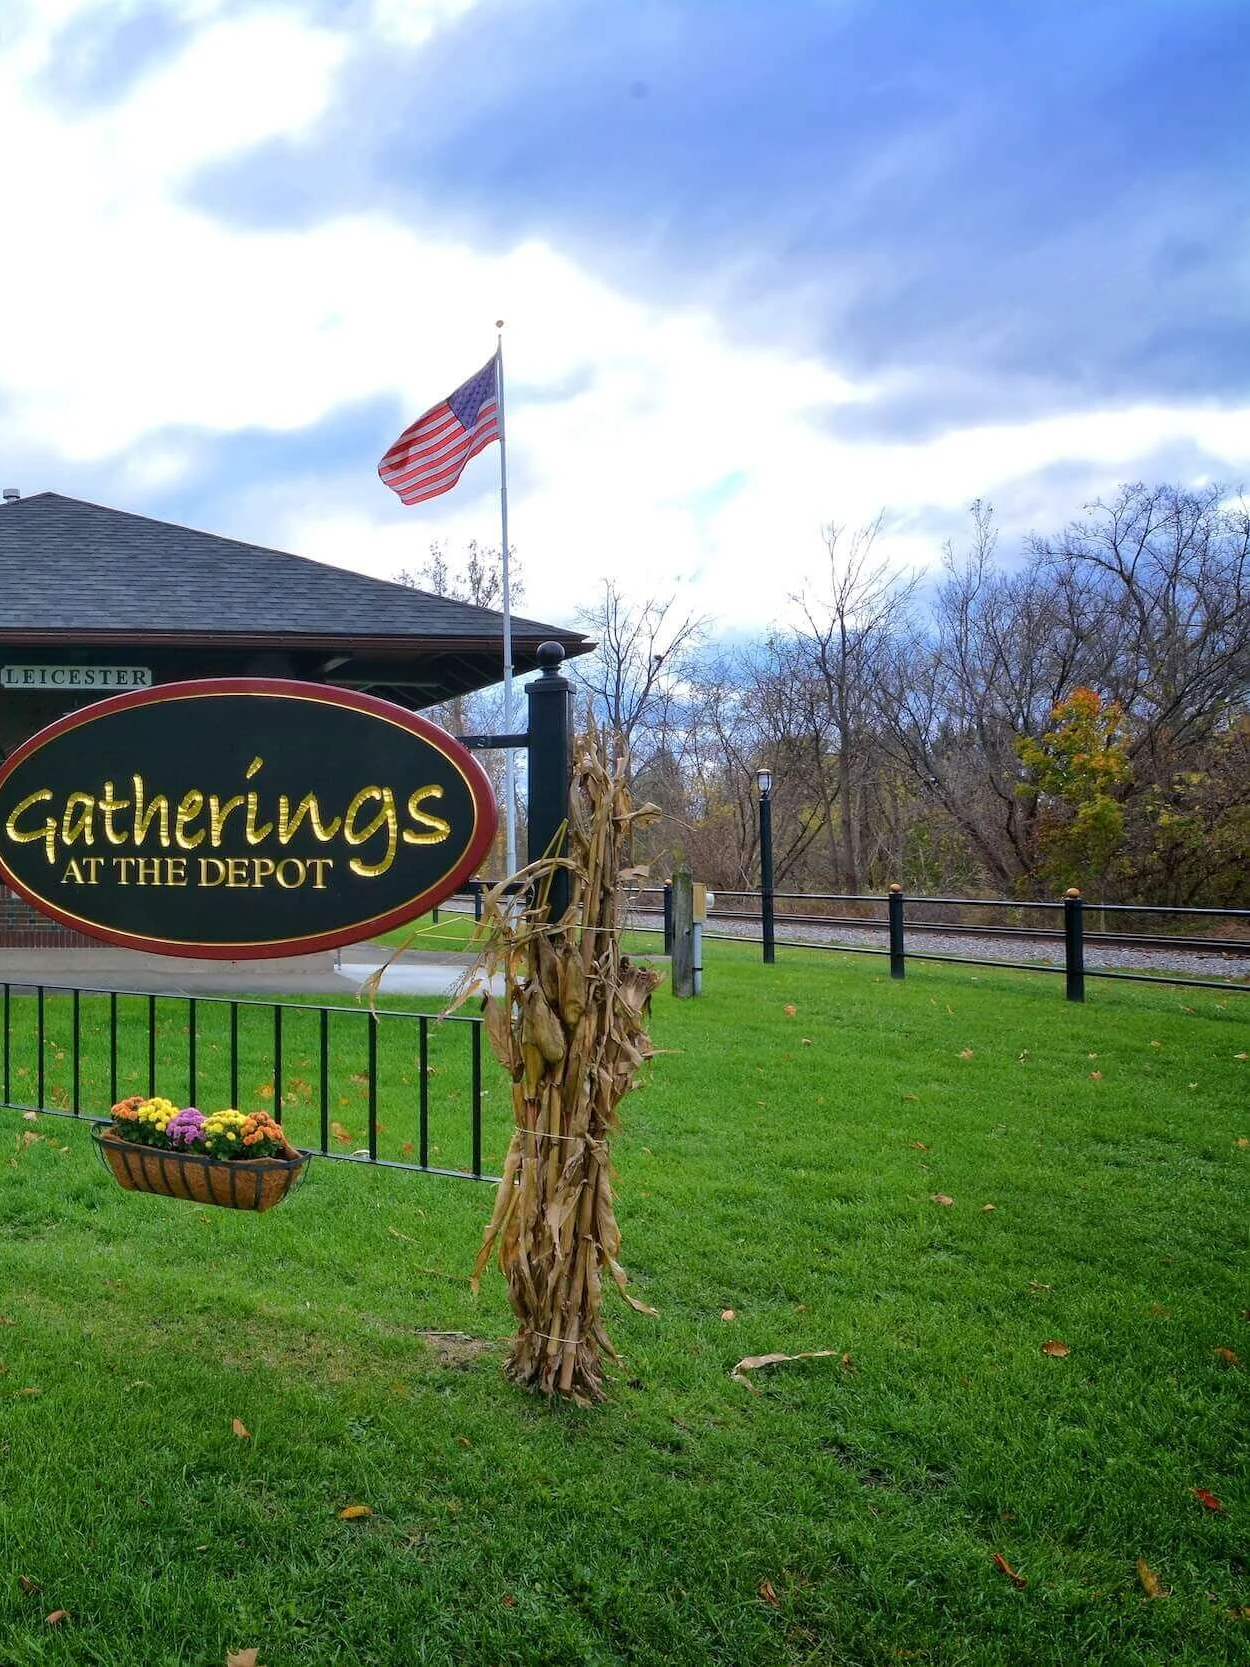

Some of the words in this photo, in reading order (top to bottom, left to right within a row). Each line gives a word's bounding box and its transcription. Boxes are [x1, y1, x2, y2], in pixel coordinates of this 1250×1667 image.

[5, 668, 147, 685] LEICESTER
[5, 757, 451, 878] Gatherings
[60, 857, 104, 885] AT
[112, 857, 187, 886] THE
[197, 857, 334, 889] DEPOT
